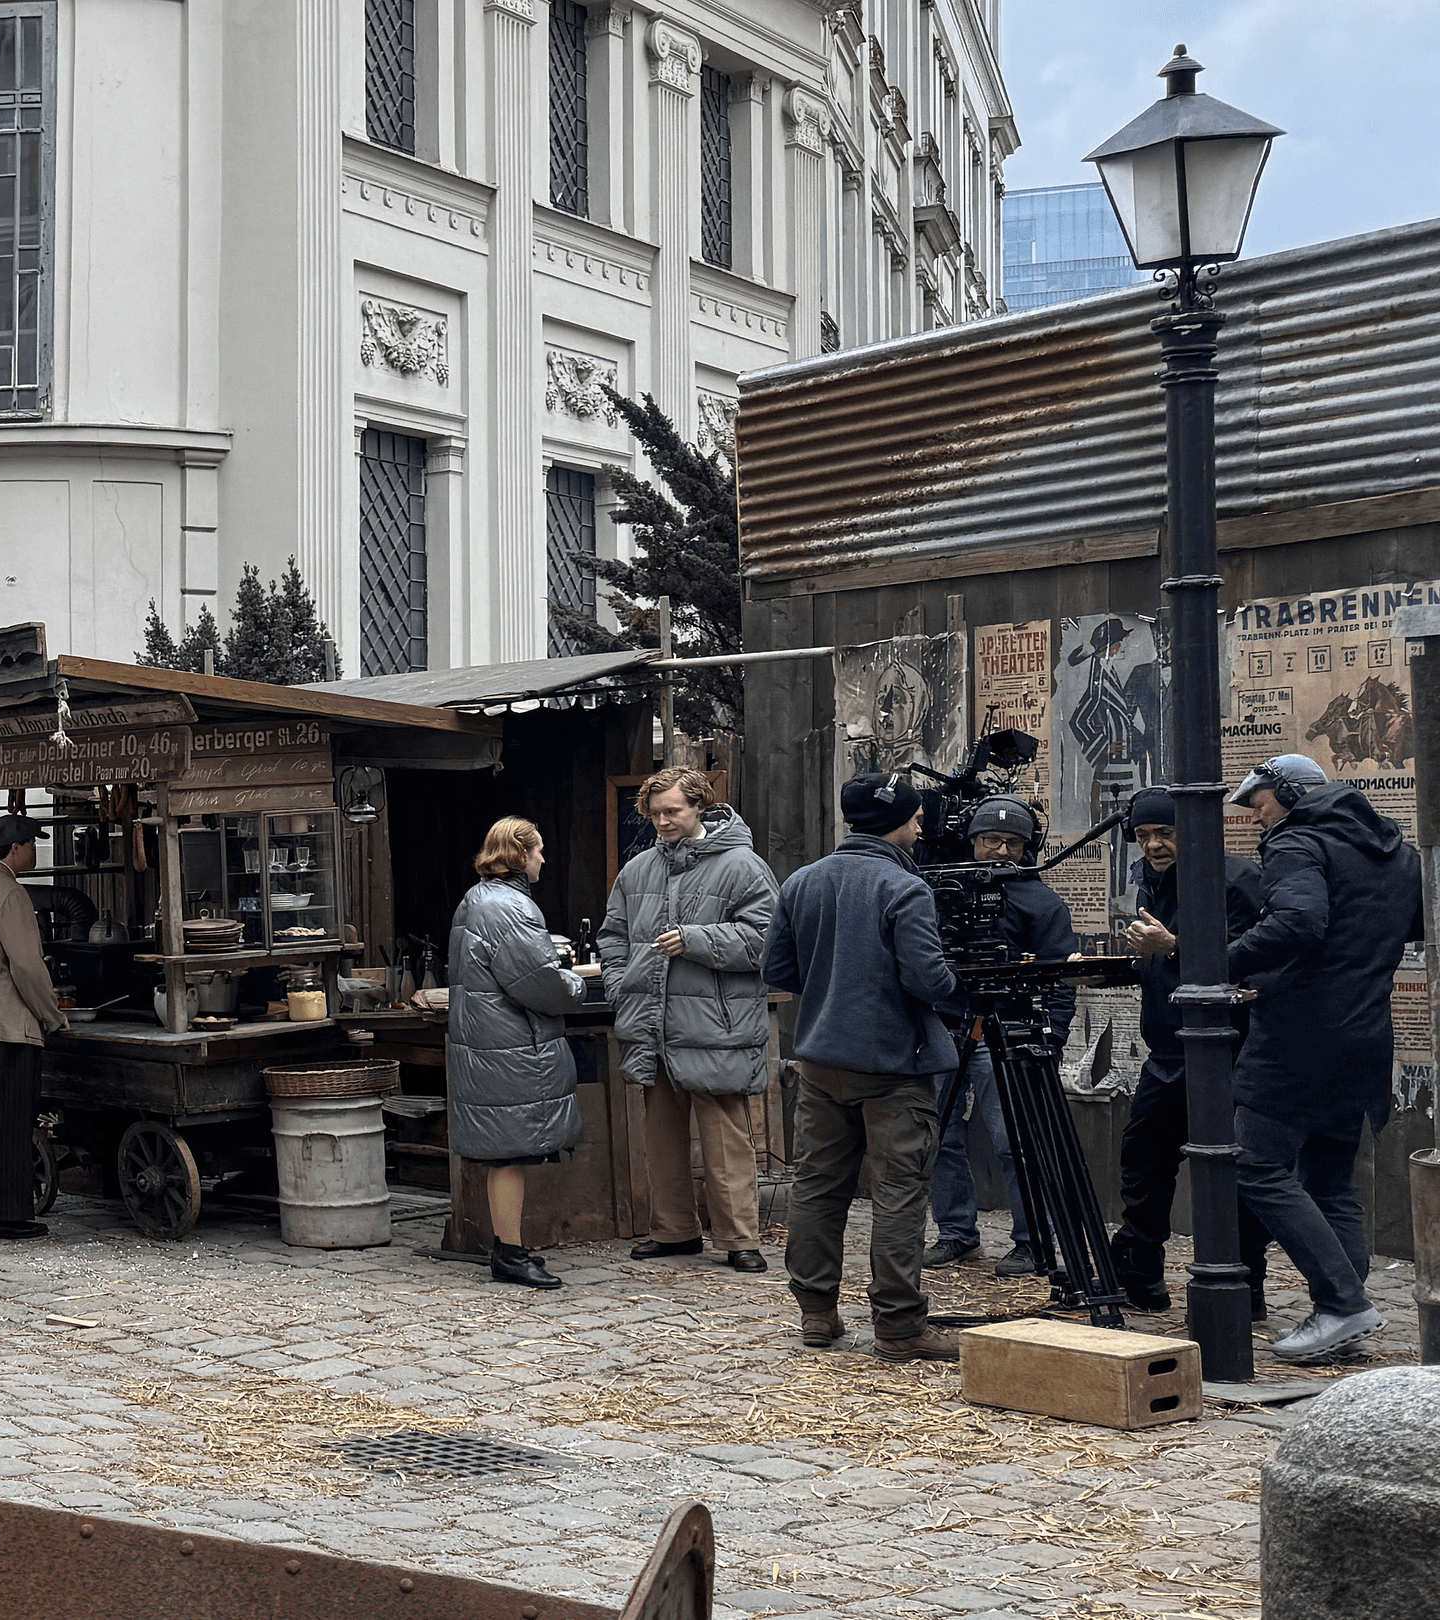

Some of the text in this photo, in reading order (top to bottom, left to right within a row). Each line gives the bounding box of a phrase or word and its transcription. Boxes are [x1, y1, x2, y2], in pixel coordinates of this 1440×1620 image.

[1312, 627, 1324, 635] IM
[1327, 624, 1360, 634] PRATER
[1364, 622, 1378, 631] BEI
[982, 652, 1045, 676] THEATER
[1287, 657, 1293, 667] 7
[1314, 653, 1326, 665] 10
[1344, 650, 1356, 662] 13
[1374, 648, 1386, 660] 17
[1221, 722, 1282, 738] MACHUNG
[192, 728, 273, 753] erberger
[38, 761, 85, 785] Würstel
[89, 762, 95, 781] 1
[1335, 777, 1416, 791] NDMACHU
